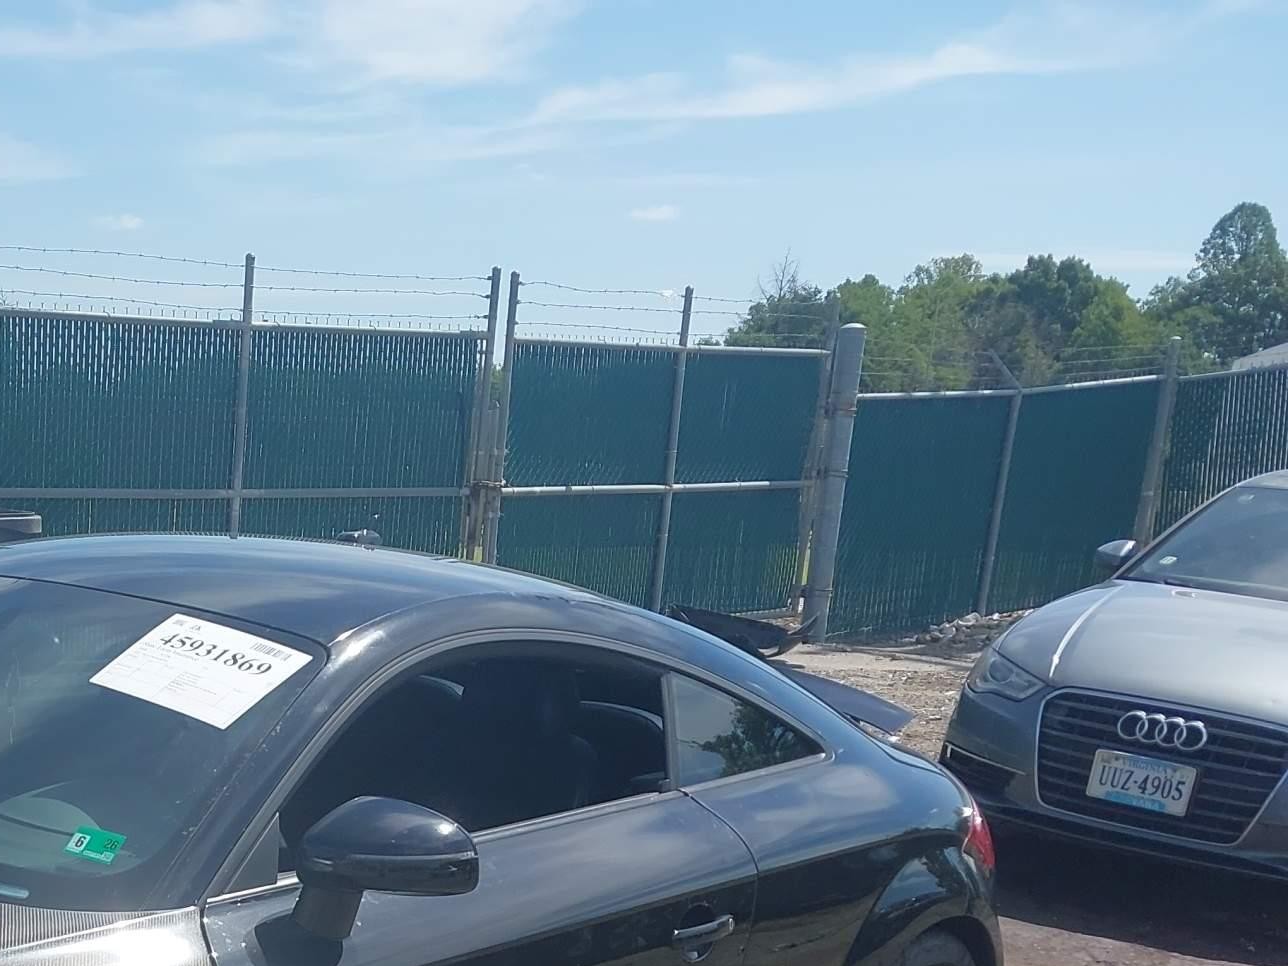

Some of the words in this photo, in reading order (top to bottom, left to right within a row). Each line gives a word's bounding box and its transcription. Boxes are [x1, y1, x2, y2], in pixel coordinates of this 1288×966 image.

[160, 633, 273, 675] 45931869
[1098, 765, 1186, 801] UUZ-4905
[75, 835, 87, 848] 6
